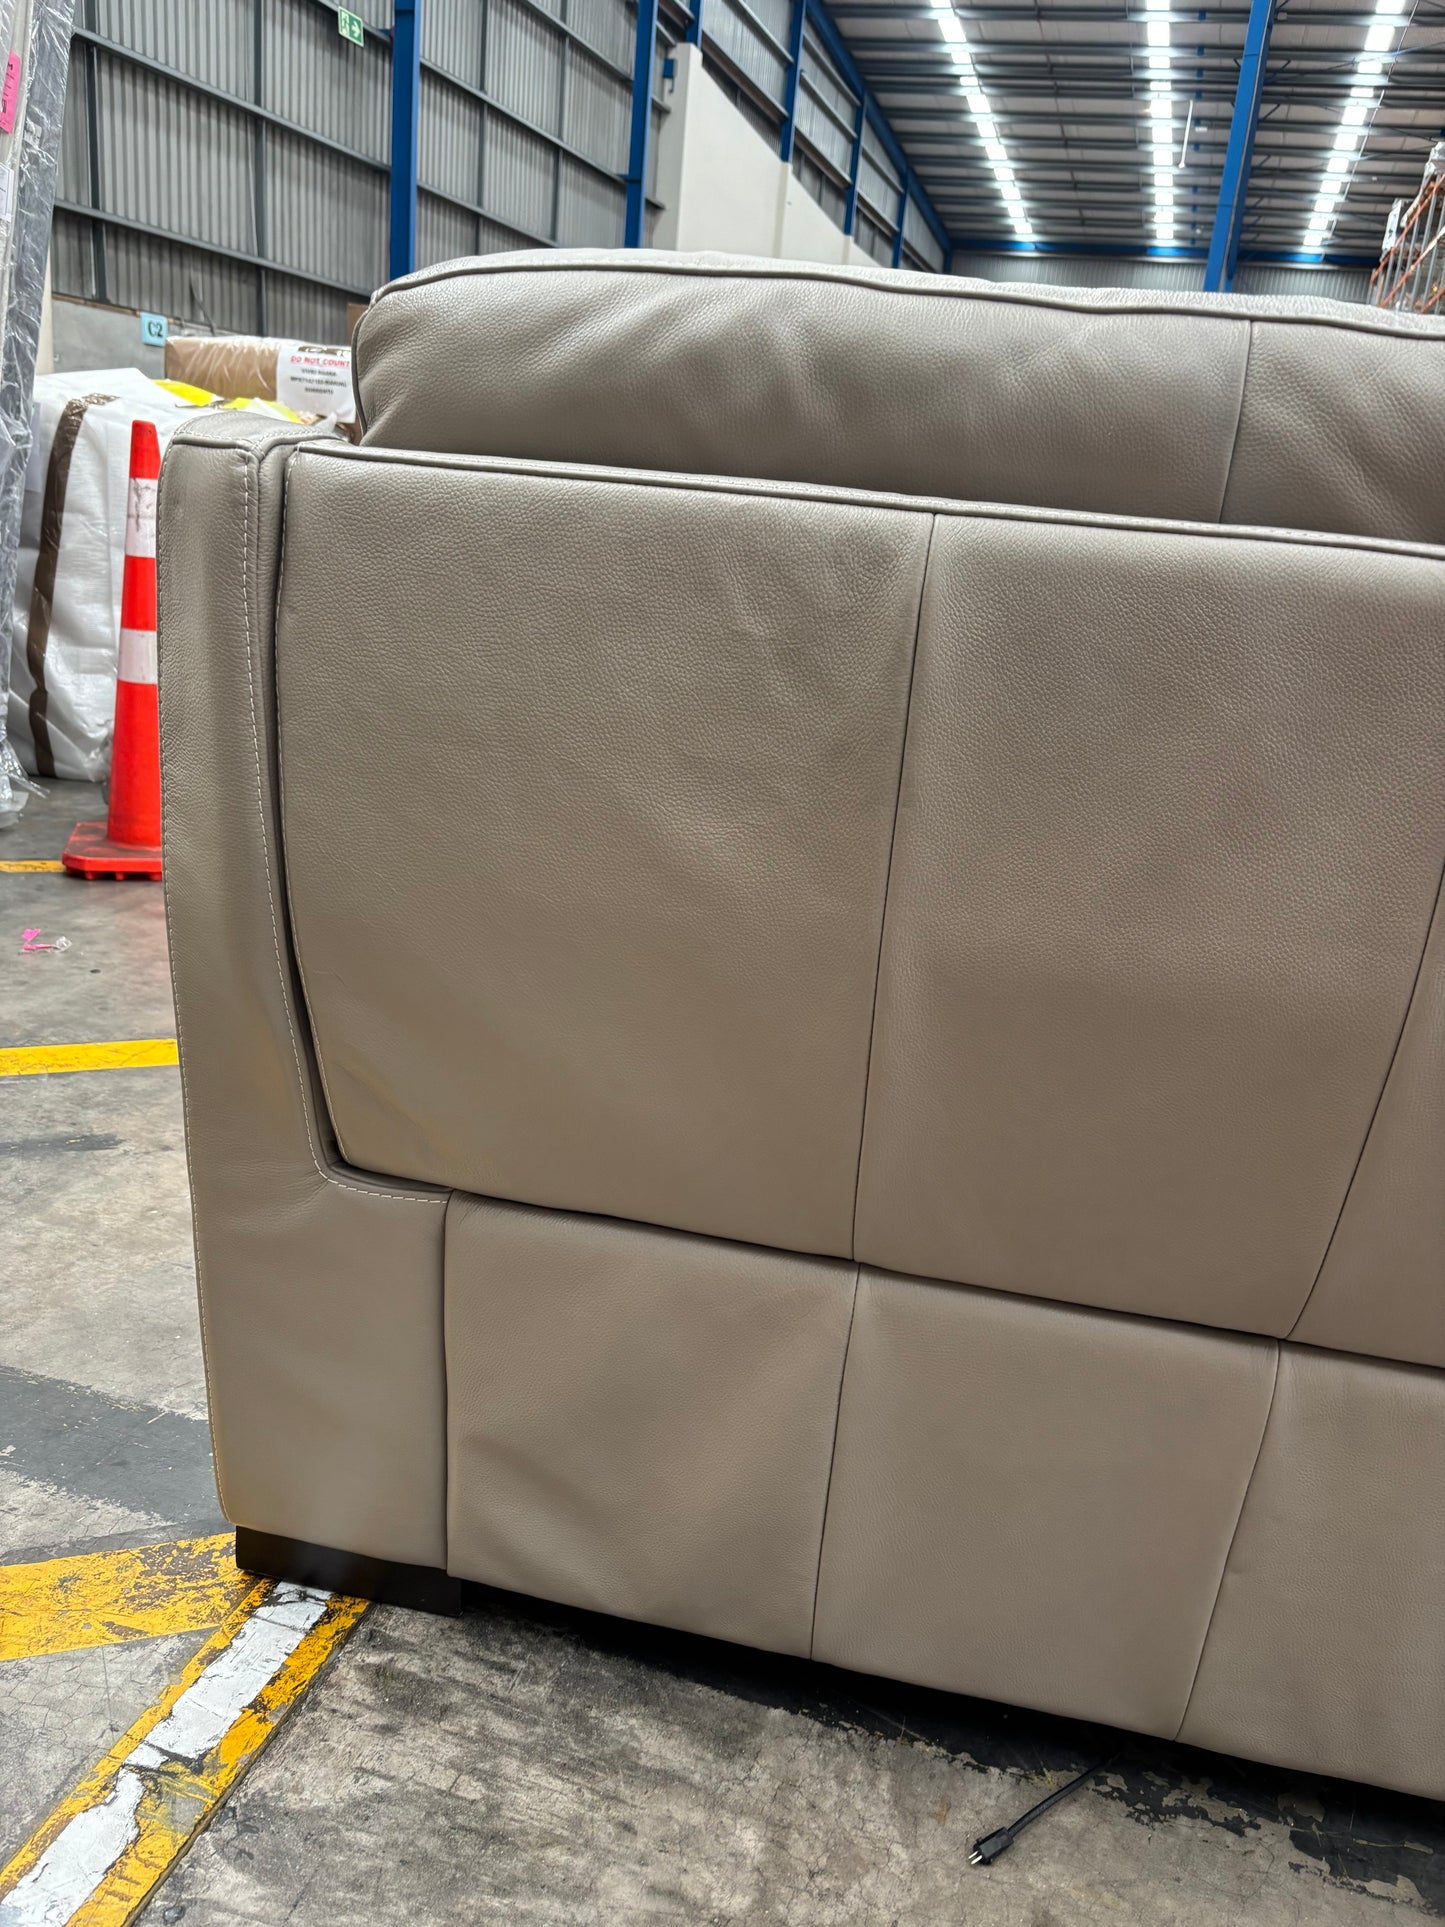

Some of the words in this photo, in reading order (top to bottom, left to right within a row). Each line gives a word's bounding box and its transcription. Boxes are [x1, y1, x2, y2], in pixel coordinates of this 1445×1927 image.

[148, 321, 163, 337] C2
[290, 355, 302, 363] DO
[304, 356, 320, 364] NOT
[322, 358, 350, 367] COUNT
